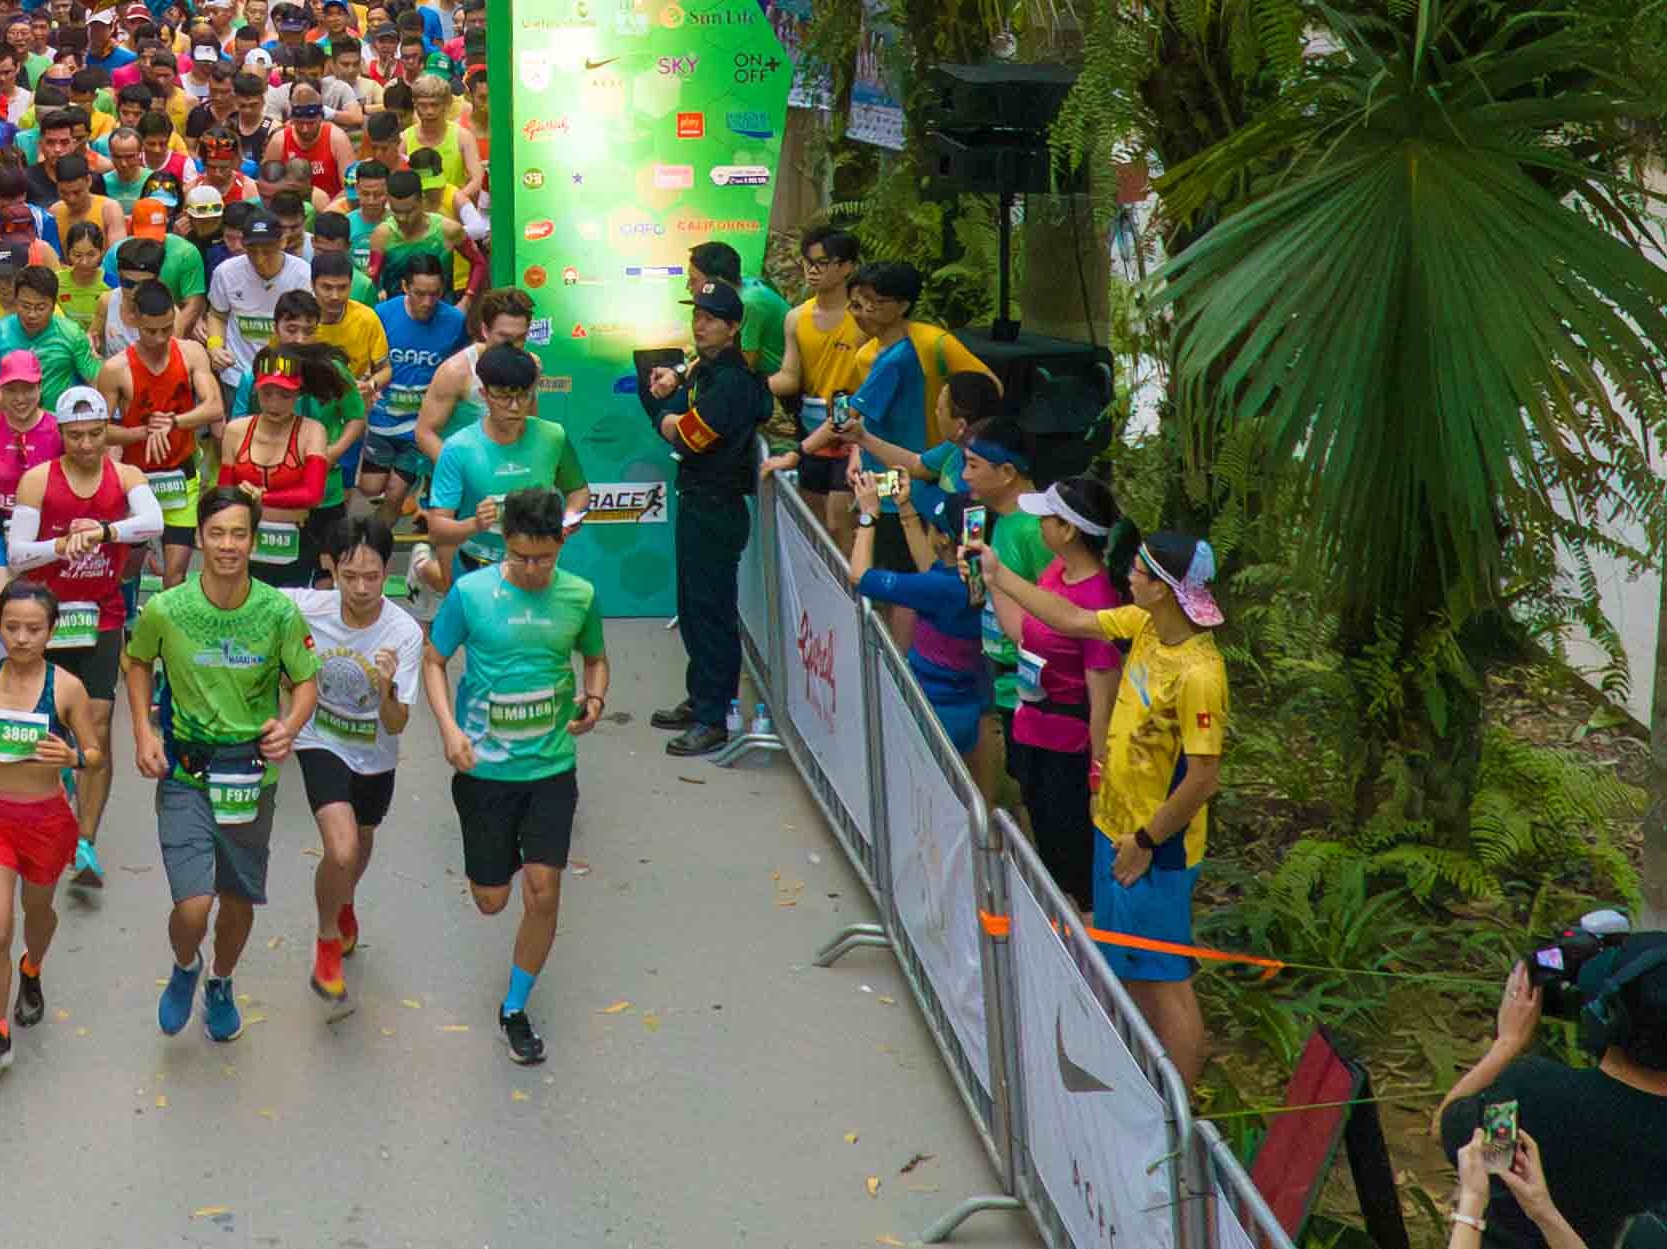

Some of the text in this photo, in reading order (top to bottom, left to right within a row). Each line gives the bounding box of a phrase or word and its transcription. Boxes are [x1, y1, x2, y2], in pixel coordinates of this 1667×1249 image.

[690, 9, 723, 25] Sun
[658, 57, 700, 74] SKY
[734, 53, 762, 67] ON
[734, 68, 765, 83] OFF
